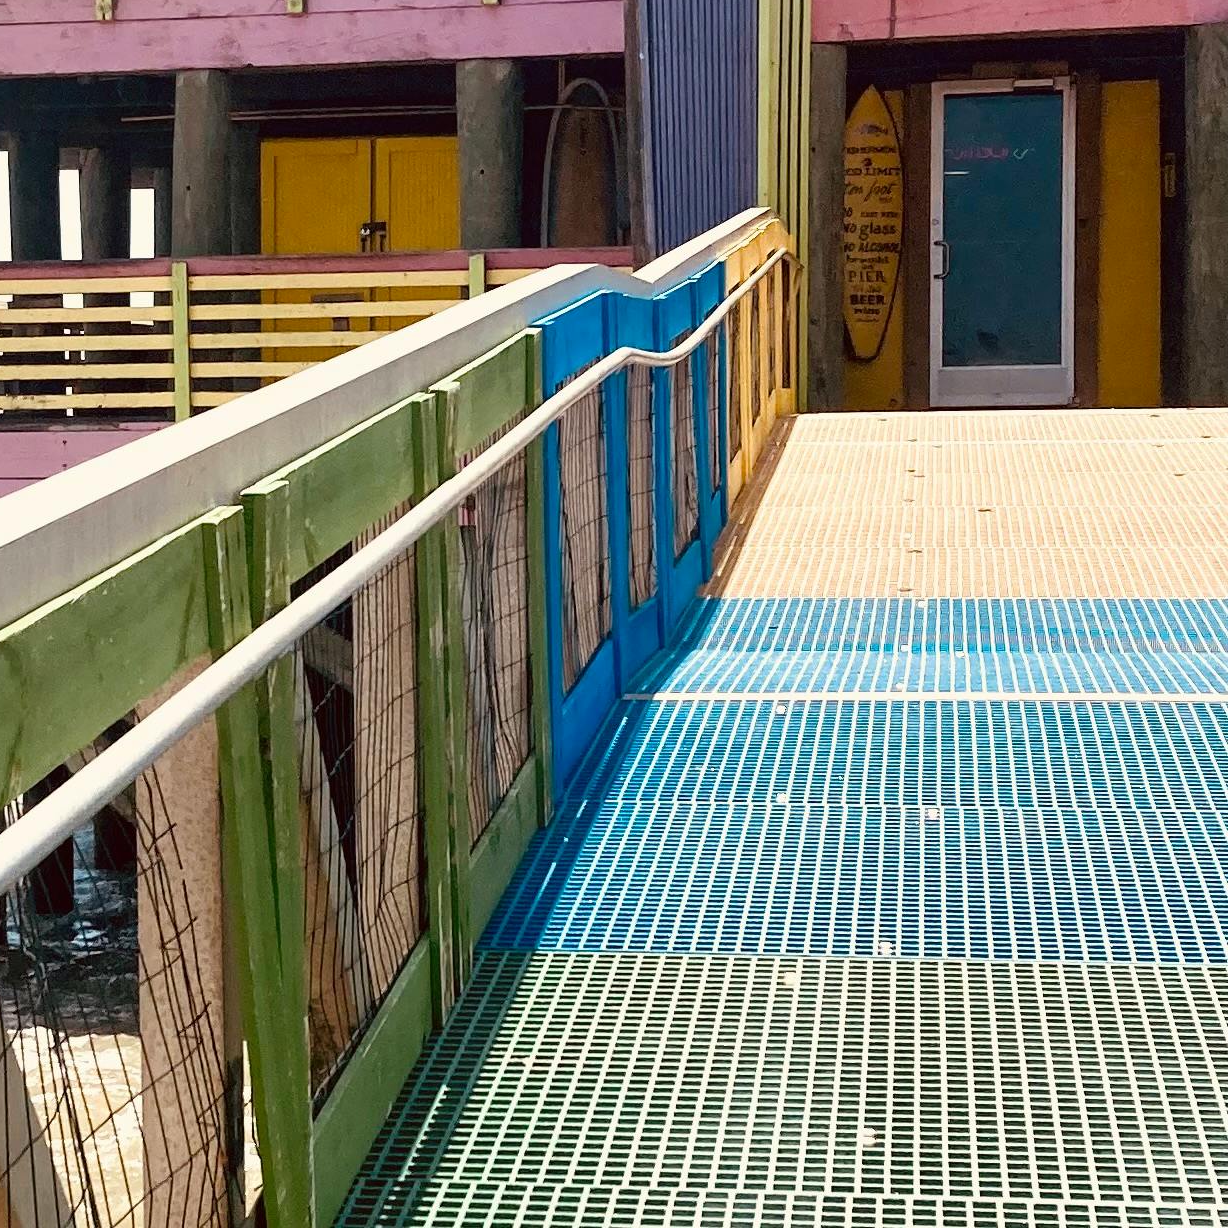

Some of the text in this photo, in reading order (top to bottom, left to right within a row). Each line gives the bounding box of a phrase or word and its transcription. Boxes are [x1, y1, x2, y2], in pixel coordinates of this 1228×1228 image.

[859, 221, 897, 242] glass
[848, 270, 888, 283] PIER
[849, 293, 887, 306] BEER
